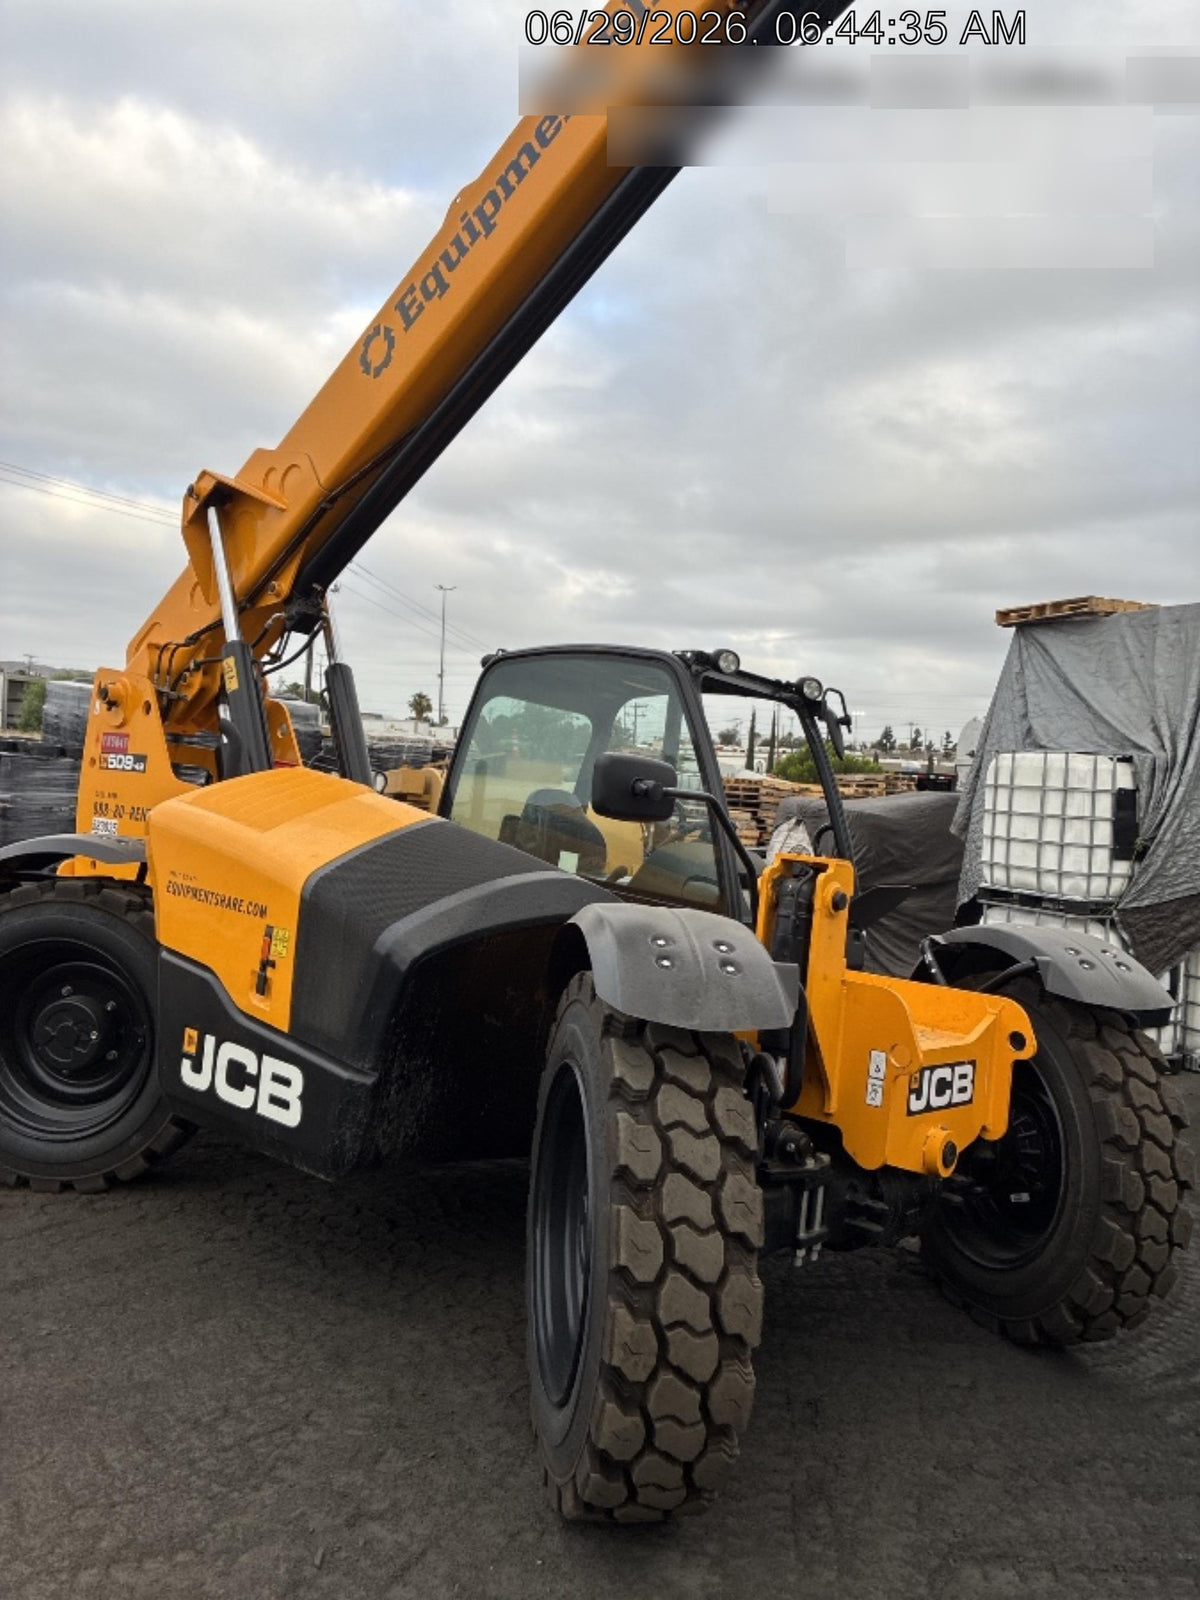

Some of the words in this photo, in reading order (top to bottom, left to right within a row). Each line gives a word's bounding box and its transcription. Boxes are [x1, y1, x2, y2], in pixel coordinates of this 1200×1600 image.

[393, 115, 572, 333] Equipme
[166, 880, 268, 919] EQUIPMENTSHARE.COM
[180, 1032, 304, 1129] JCB
[908, 1064, 975, 1112] JCB
